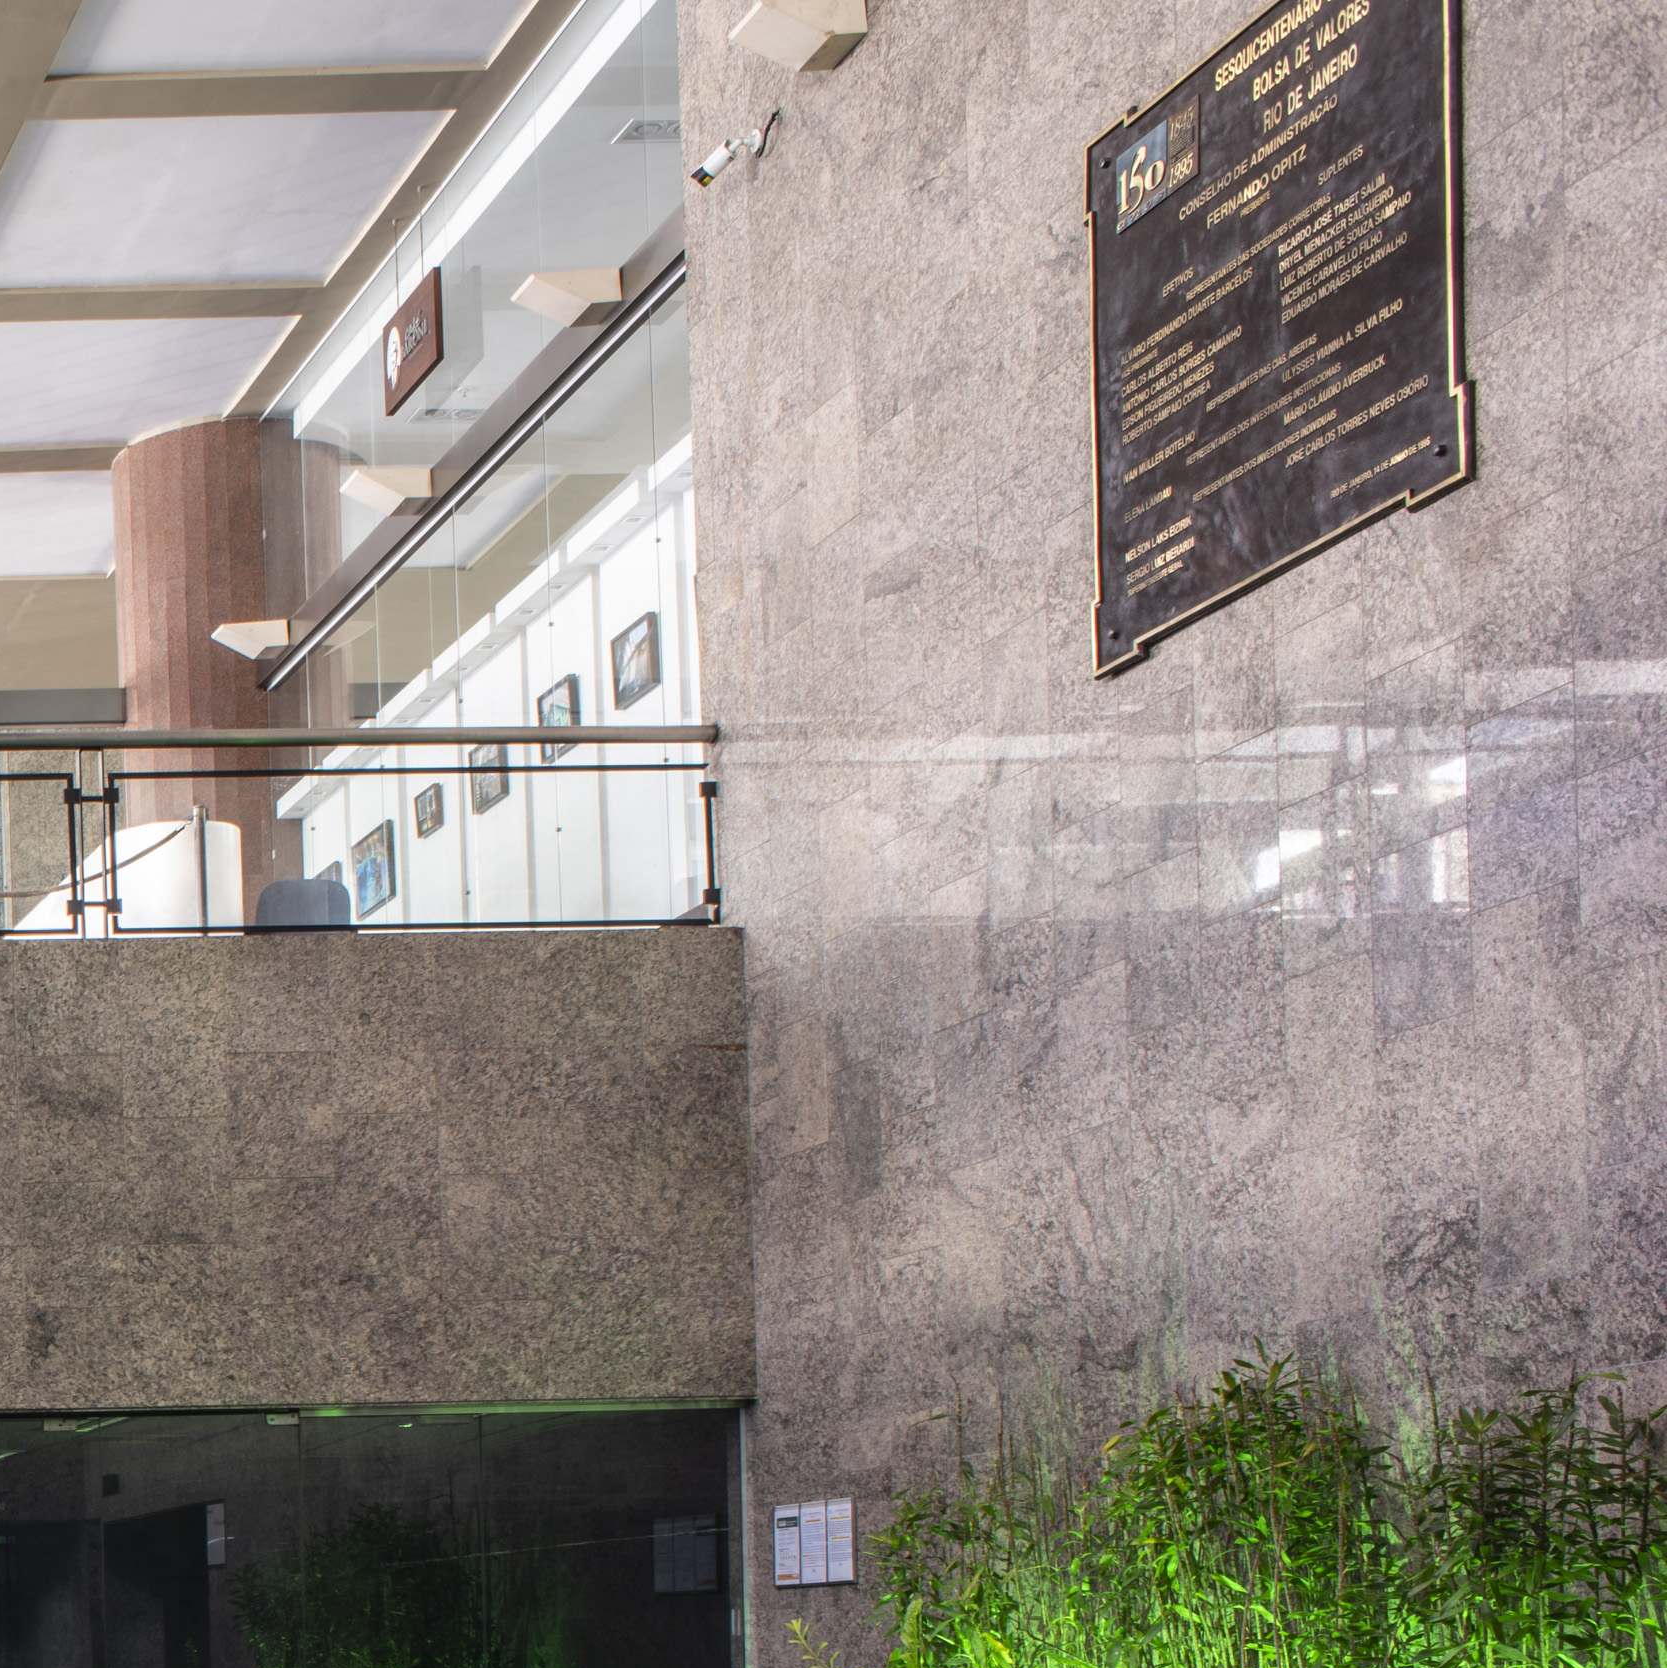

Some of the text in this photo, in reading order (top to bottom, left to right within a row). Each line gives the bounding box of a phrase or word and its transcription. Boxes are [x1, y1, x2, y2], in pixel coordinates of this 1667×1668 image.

[1253, 0, 1370, 101] BOLSA DE VALORES
[1263, 43, 1358, 133] RIO DE JANEIRO
[1170, 105, 1195, 140] 1845
[1179, 171, 1232, 221] CONSELHO
[1233, 162, 1248, 181] DE
[1250, 93, 1338, 169] ADMINISTRAÇÃO
[1119, 146, 1166, 215] 150
[1169, 152, 1193, 187] 1995
[1207, 144, 1307, 229] FERNANDO OPITZ
[1240, 190, 1271, 218] PRESIDENTE
[1162, 144, 1364, 297] EFETIVOS SUPLENTES
[1186, 192, 1331, 301] REPRESENTANTES DAS SOCIEDADES CORRETORAS
[1278, 173, 1386, 257] RICARDO JOSÉ TABET SALIM
[1279, 185, 1394, 274] DRYEL MENACKER SALGUEIRO
[1280, 191, 1412, 291] LUIZ ROBERTO DE SOUZA SAMPAIO
[1147, 313, 1187, 349] FERDINANDO
[1188, 291, 1216, 321] DUARTE
[1216, 266, 1253, 300] BARCELOS
[1281, 230, 1383, 307] VICENTE CARAVELLO FILHO
[1281, 231, 1408, 324] EDUARDO MORAES DE CARVALHO
[1121, 341, 1194, 398] CARLOS ALBERTO REIS
[1122, 325, 1242, 415] ANTÔNIO CARLOS BORGES CAMANHO
[1206, 372, 1259, 412] REPRESENTANTES
[1259, 362, 1271, 379] DAS
[1288, 333, 1318, 360] ABERTAS
[1282, 298, 1403, 384] ULYSSES VIANNA A. SILVA FILHO
[1122, 408, 1144, 431] EDSON
[1183, 361, 1215, 390] MENEZES
[1122, 380, 1211, 446] ROBERTO SAMPAIO CORREA
[1186, 362, 1342, 467] REPRESENTANTES DOS INVESTIDORES INSTITUCIONAIS
[1284, 353, 1386, 426] MÁRIO CLÁUDIO AVERBUCK
[1285, 374, 1429, 469] JOSÉ CARLOS TORRES NEVES OSÓRIO
[1165, 430, 1196, 458] BOTELHO
[1192, 408, 1337, 504] REPRESENTANTES DOS INVESTIDORES INDIVIDUAIS
[1330, 486, 1340, 499] RIO
[1340, 481, 1348, 493] DE
[1380, 459, 1389, 471] DE
[1389, 448, 1409, 466] JUNHO
[1408, 444, 1417, 456] DE
[1124, 485, 1173, 524] ELENA LANDAU
[1125, 539, 1151, 564] NELSON
[1151, 529, 1169, 548] LAKS
[1151, 552, 1166, 570] LUIZ
[1165, 535, 1196, 562] BERARDI
